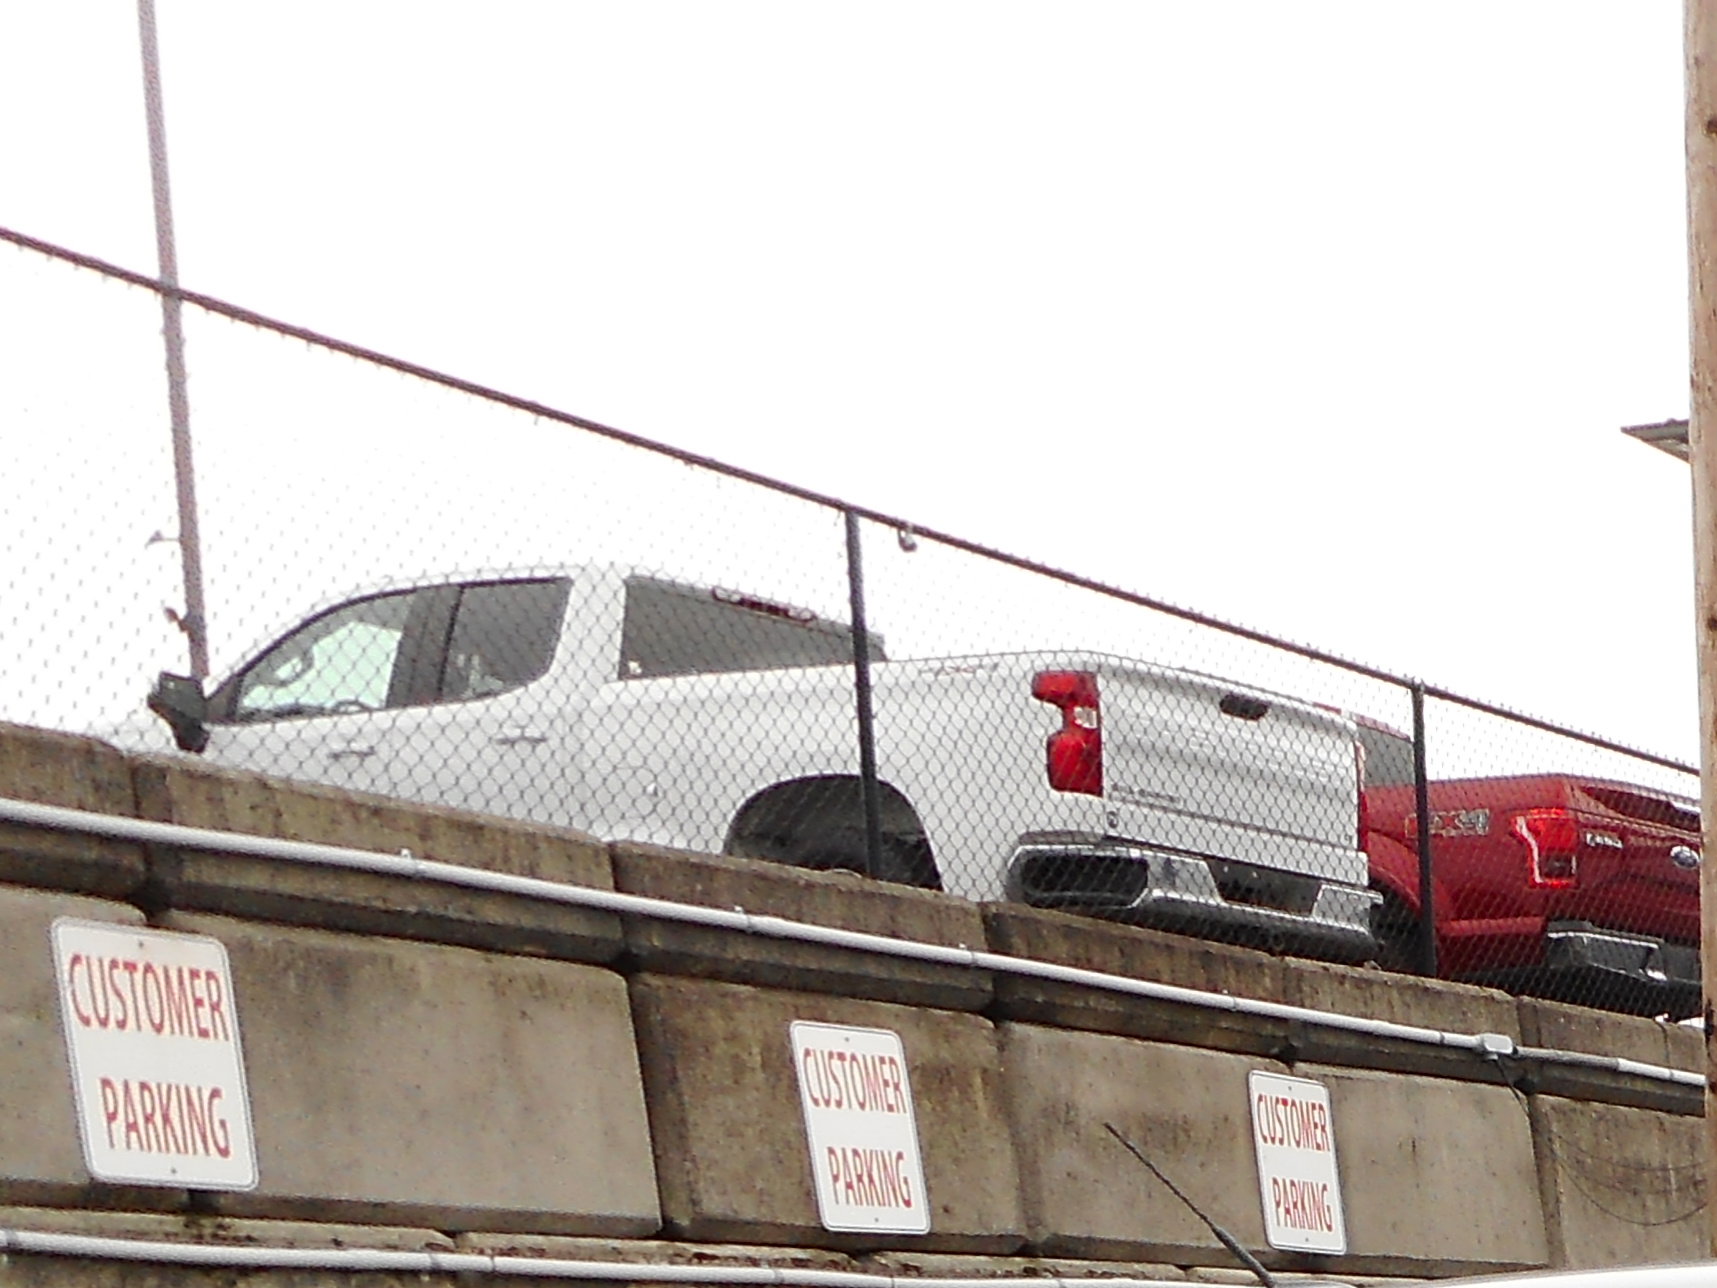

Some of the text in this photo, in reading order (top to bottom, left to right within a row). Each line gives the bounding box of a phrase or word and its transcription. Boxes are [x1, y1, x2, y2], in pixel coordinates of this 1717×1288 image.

[67, 953, 230, 1043] CUSTOMER
[802, 1046, 907, 1115] CUSTOMER
[100, 1077, 232, 1159] PARKING
[1256, 1093, 1329, 1153] CUSTOMER
[826, 1146, 914, 1209] PARKING
[1271, 1177, 1334, 1233] PARKING
